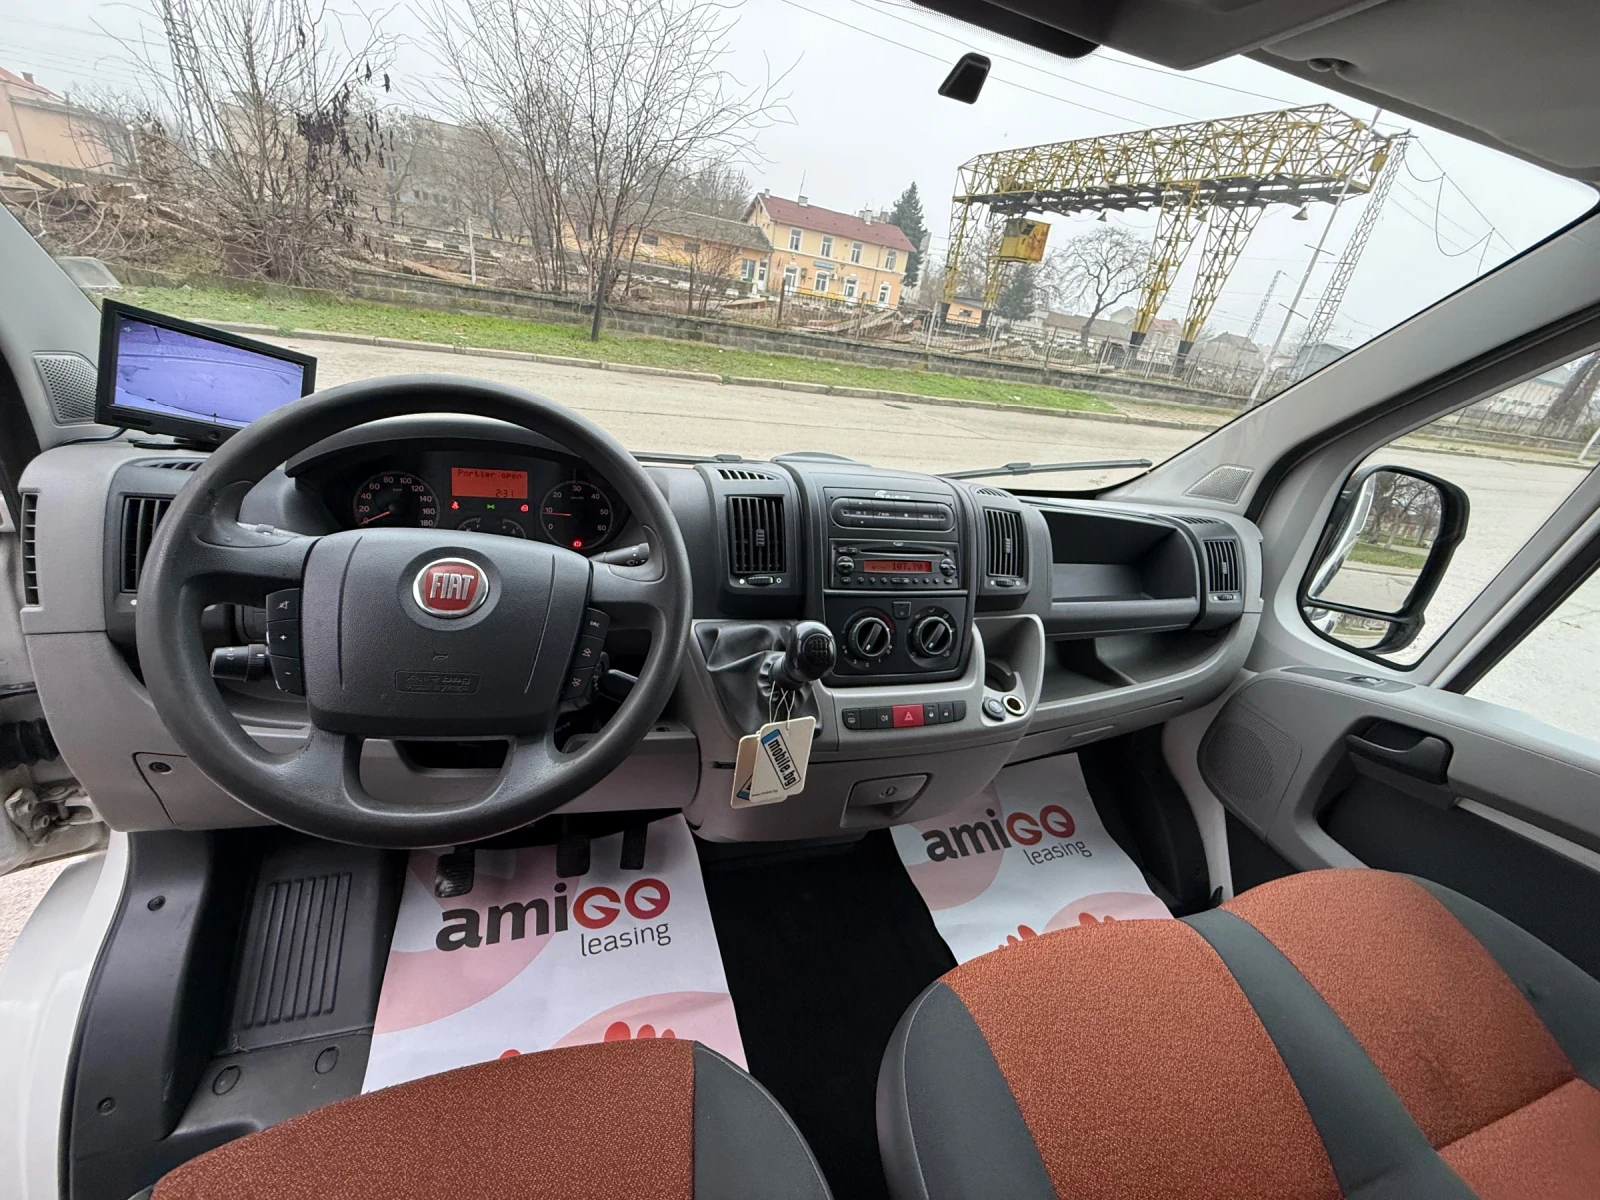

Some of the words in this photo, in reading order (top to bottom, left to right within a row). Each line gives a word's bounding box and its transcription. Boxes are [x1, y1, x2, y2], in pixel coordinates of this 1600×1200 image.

[458, 470, 495, 478] Portier
[430, 573, 475, 600] FIAT
[768, 739, 796, 787] mobile.bg
[922, 805, 1075, 862] amiGO
[1023, 841, 1092, 866] leasing
[436, 878, 671, 952] amiGO
[581, 923, 671, 957] leasing
